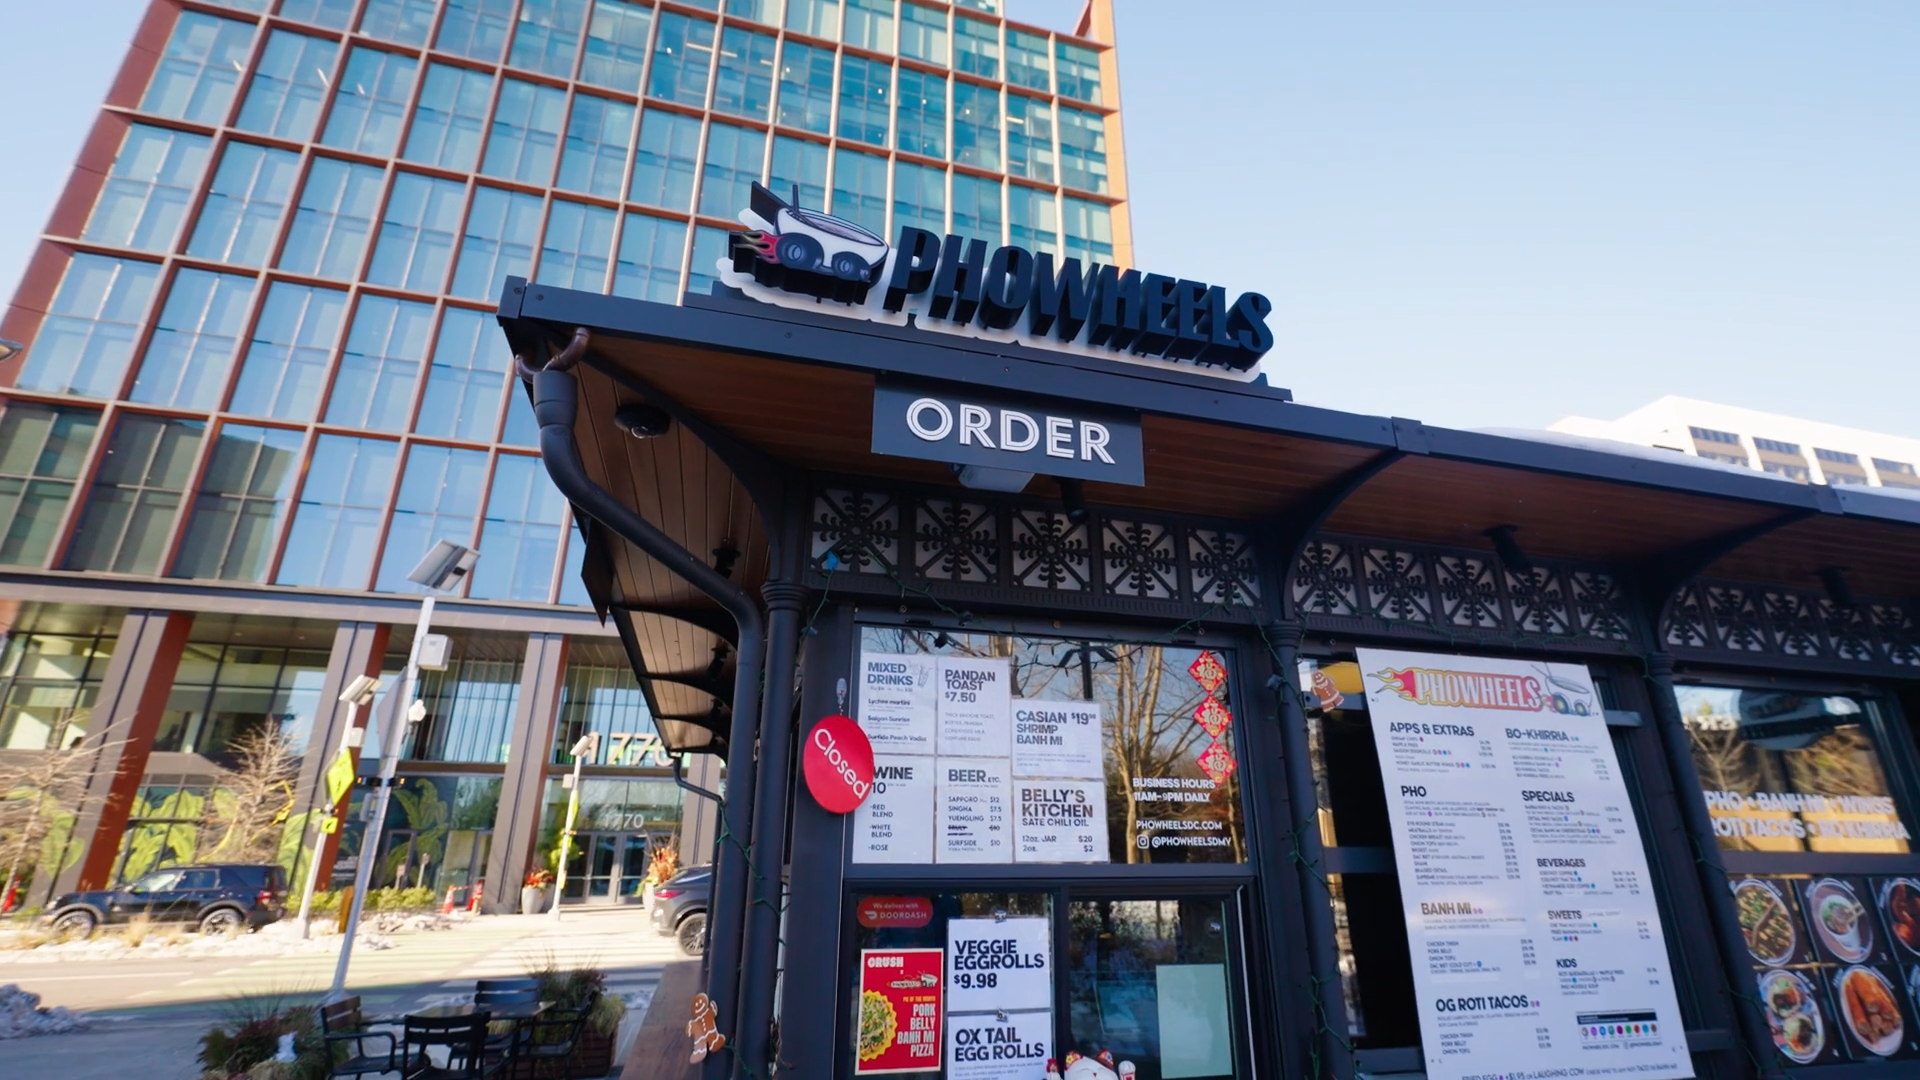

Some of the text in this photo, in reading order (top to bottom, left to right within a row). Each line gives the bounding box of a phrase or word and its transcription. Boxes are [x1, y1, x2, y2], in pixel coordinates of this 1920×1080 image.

[883, 225, 1275, 370] PHOWHEELS
[906, 397, 1116, 465] ORDER
[867, 661, 907, 674] MIXED
[867, 673, 914, 686] DRINKS
[945, 669, 996, 682] PANDAN
[945, 679, 984, 691] TOAST
[1414, 671, 1542, 711] PHOWHEELS
[945, 691, 977, 703] $7.50
[1016, 709, 1067, 724] CASIAN
[1016, 723, 1058, 734] SHRIMP
[1390, 722, 1474, 737] APPS & EXTRAS
[1505, 727, 1569, 741] BO-KHIRRIA
[1016, 734, 1063, 746] BANH MI
[814, 728, 869, 799] Closed
[872, 766, 913, 780] WINE
[948, 768, 986, 782] BEER
[1132, 778, 1216, 789] BUSINESS HOURS
[1021, 788, 1086, 803] BELLY'S
[1184, 792, 1211, 802] DAILY
[1401, 785, 1427, 797] PHO
[1522, 790, 1575, 802] SPECIALS
[1703, 790, 1744, 811] PHO
[1755, 791, 1805, 813] BANH
[1840, 795, 1896, 815] WINGS
[1021, 803, 1093, 818] KITCHEN
[605, 813, 645, 829] 1770
[1022, 817, 1089, 827] SATE CHILI OIL
[1136, 820, 1222, 831] PHOWHEELSDC.COM
[1748, 817, 1806, 839] TACOS
[990, 839, 1000, 847] $10
[1078, 835, 1093, 843] $20
[1151, 836, 1232, 847] @PHOWHEELSDMV
[1536, 858, 1586, 868] BEVERAGES
[879, 911, 927, 919] DOORDASH
[1420, 901, 1472, 915] BANH MI
[1547, 910, 1582, 920] SWEETS
[954, 939, 1017, 954] VEGGIE
[867, 956, 904, 968] CRUSH
[954, 953, 1045, 970] EGGROLLS
[1556, 958, 1577, 968] KIDS
[953, 972, 998, 989] $9.98
[913, 1003, 936, 1017] PORK
[1435, 994, 1529, 1012] OG ROTI TACOS
[910, 1017, 936, 1030] BELLY
[897, 1030, 935, 1044] BANH MI
[955, 1028, 1022, 1045] OX TAIL
[910, 1043, 934, 1057] PIZZA
[955, 1042, 1045, 1062] EGG ROLLS
